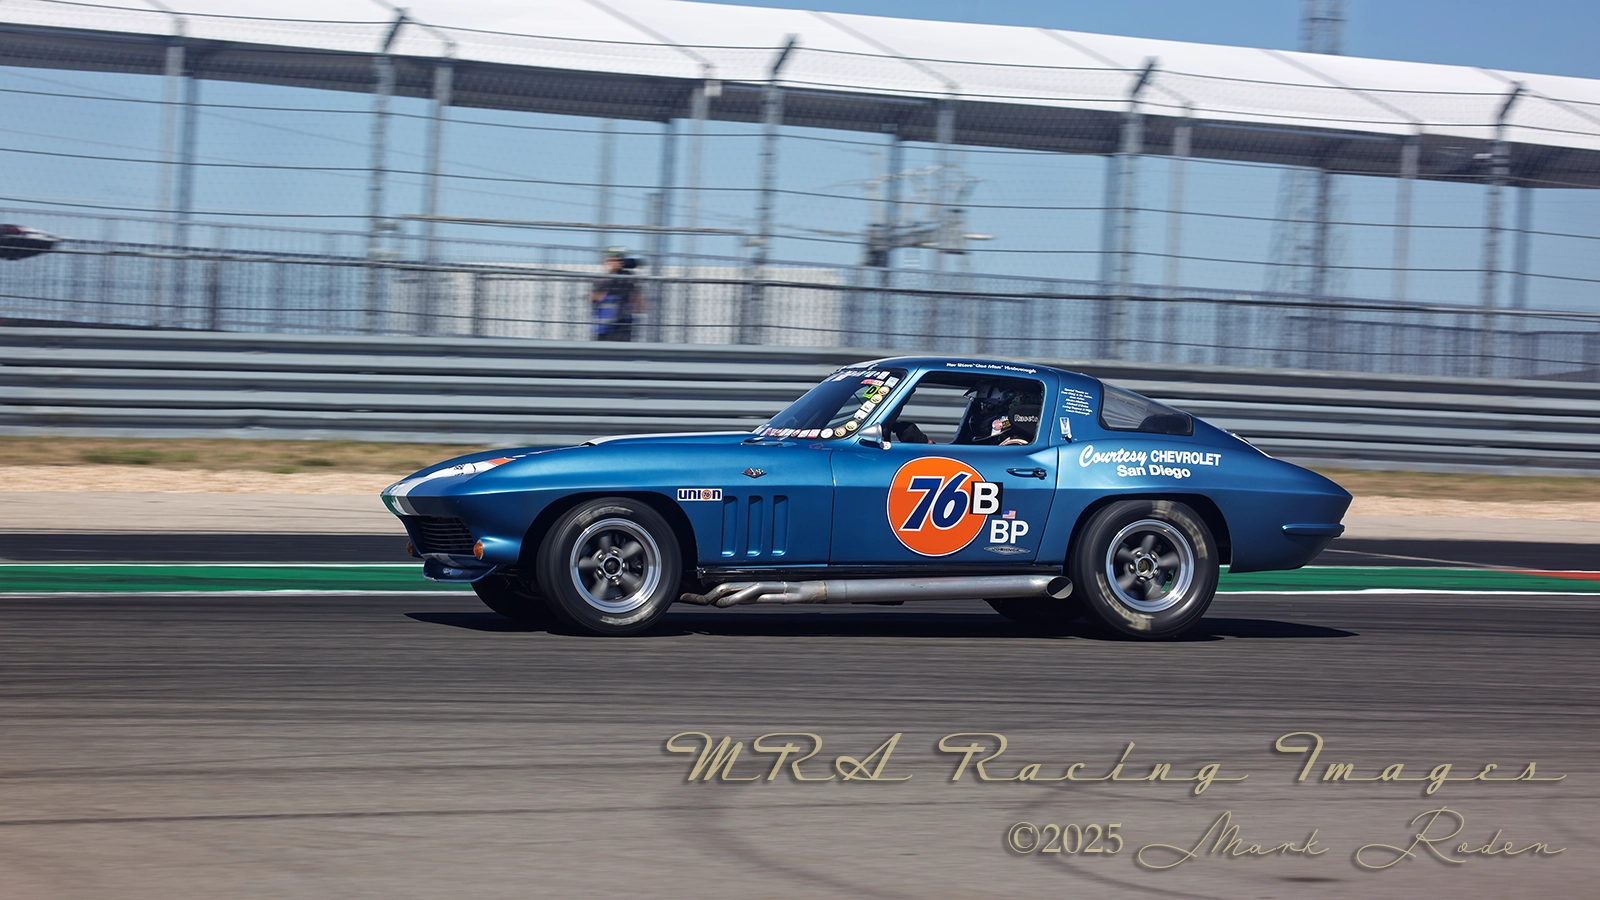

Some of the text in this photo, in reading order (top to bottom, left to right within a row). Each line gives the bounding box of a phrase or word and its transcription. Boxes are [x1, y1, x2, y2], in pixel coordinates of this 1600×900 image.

[1078, 445, 1222, 467] Courtesy CHEVROLET
[1116, 465, 1191, 479] San Diego
[898, 470, 1000, 532] 76 B
[989, 519, 1029, 544] BP
